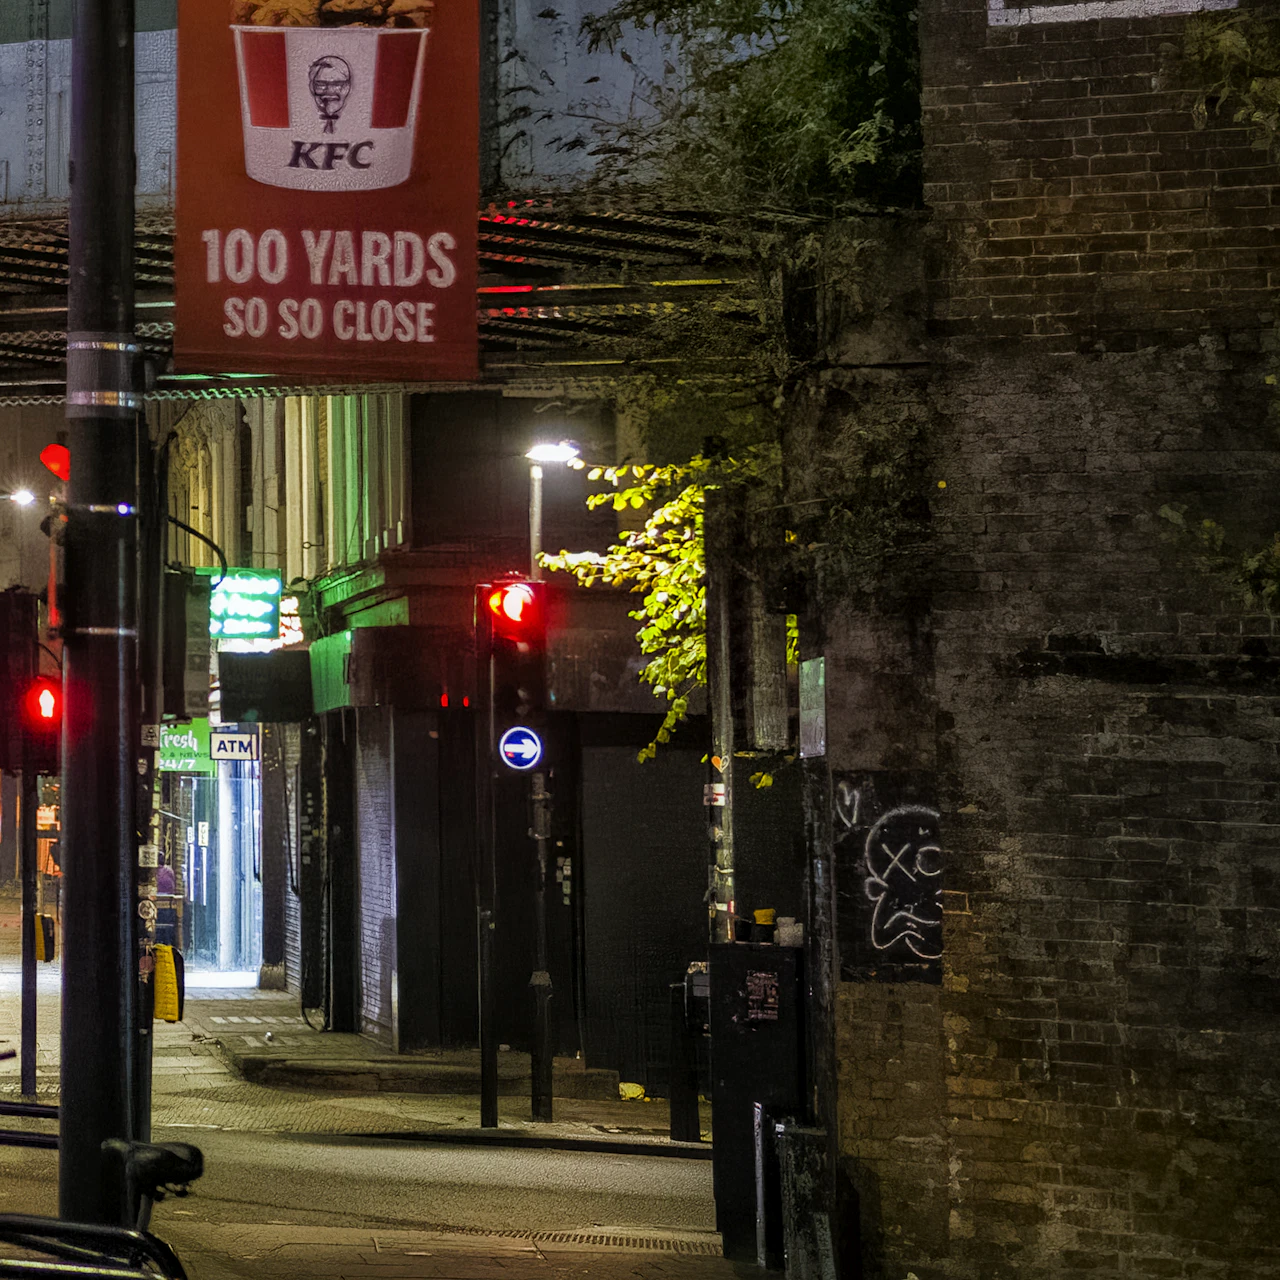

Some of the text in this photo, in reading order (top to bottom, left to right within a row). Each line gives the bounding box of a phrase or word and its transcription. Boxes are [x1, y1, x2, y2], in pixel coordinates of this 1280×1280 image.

[287, 140, 375, 170] KFC
[202, 228, 457, 289] 100 YARDS
[223, 297, 436, 343] SO SO CLOSE
[217, 740, 252, 753] ATM
